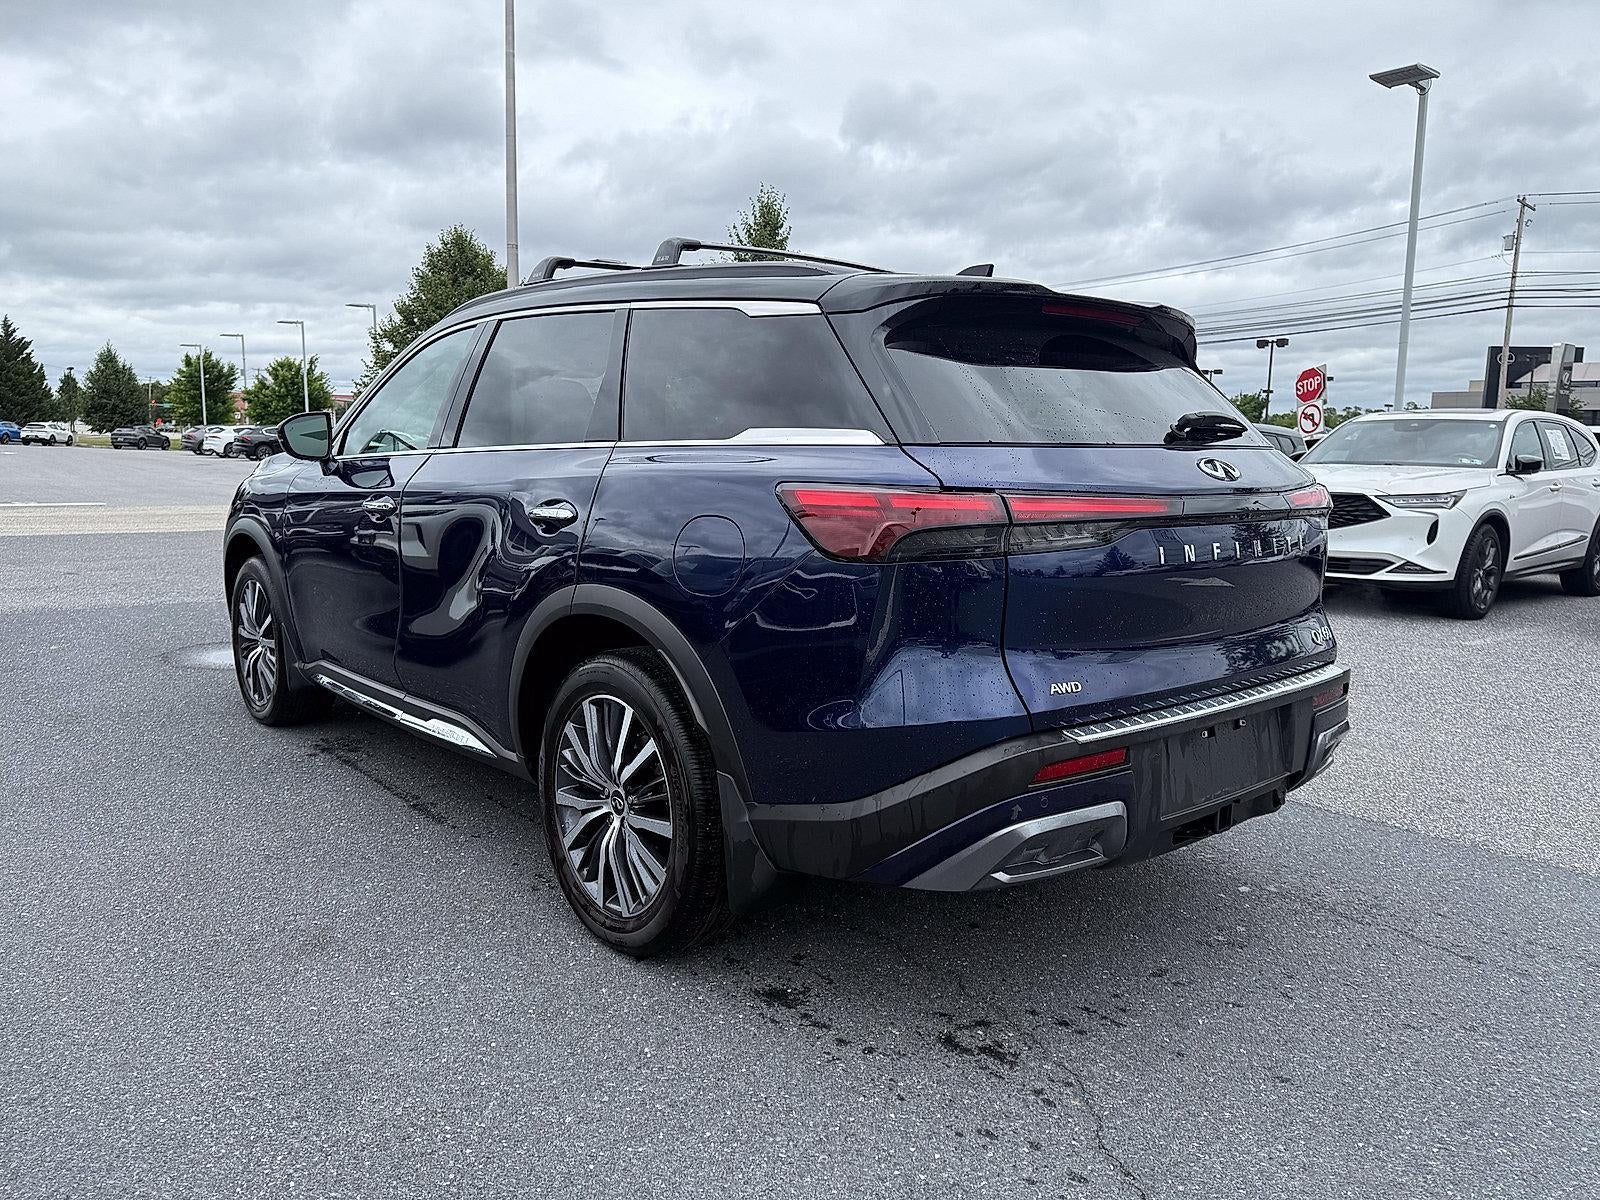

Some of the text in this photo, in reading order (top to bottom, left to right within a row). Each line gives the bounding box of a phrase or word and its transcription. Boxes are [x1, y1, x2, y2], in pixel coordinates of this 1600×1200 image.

[1296, 376, 1321, 395] STOP
[1158, 535, 1304, 565] INFINITI
[1050, 681, 1083, 695] AWD
